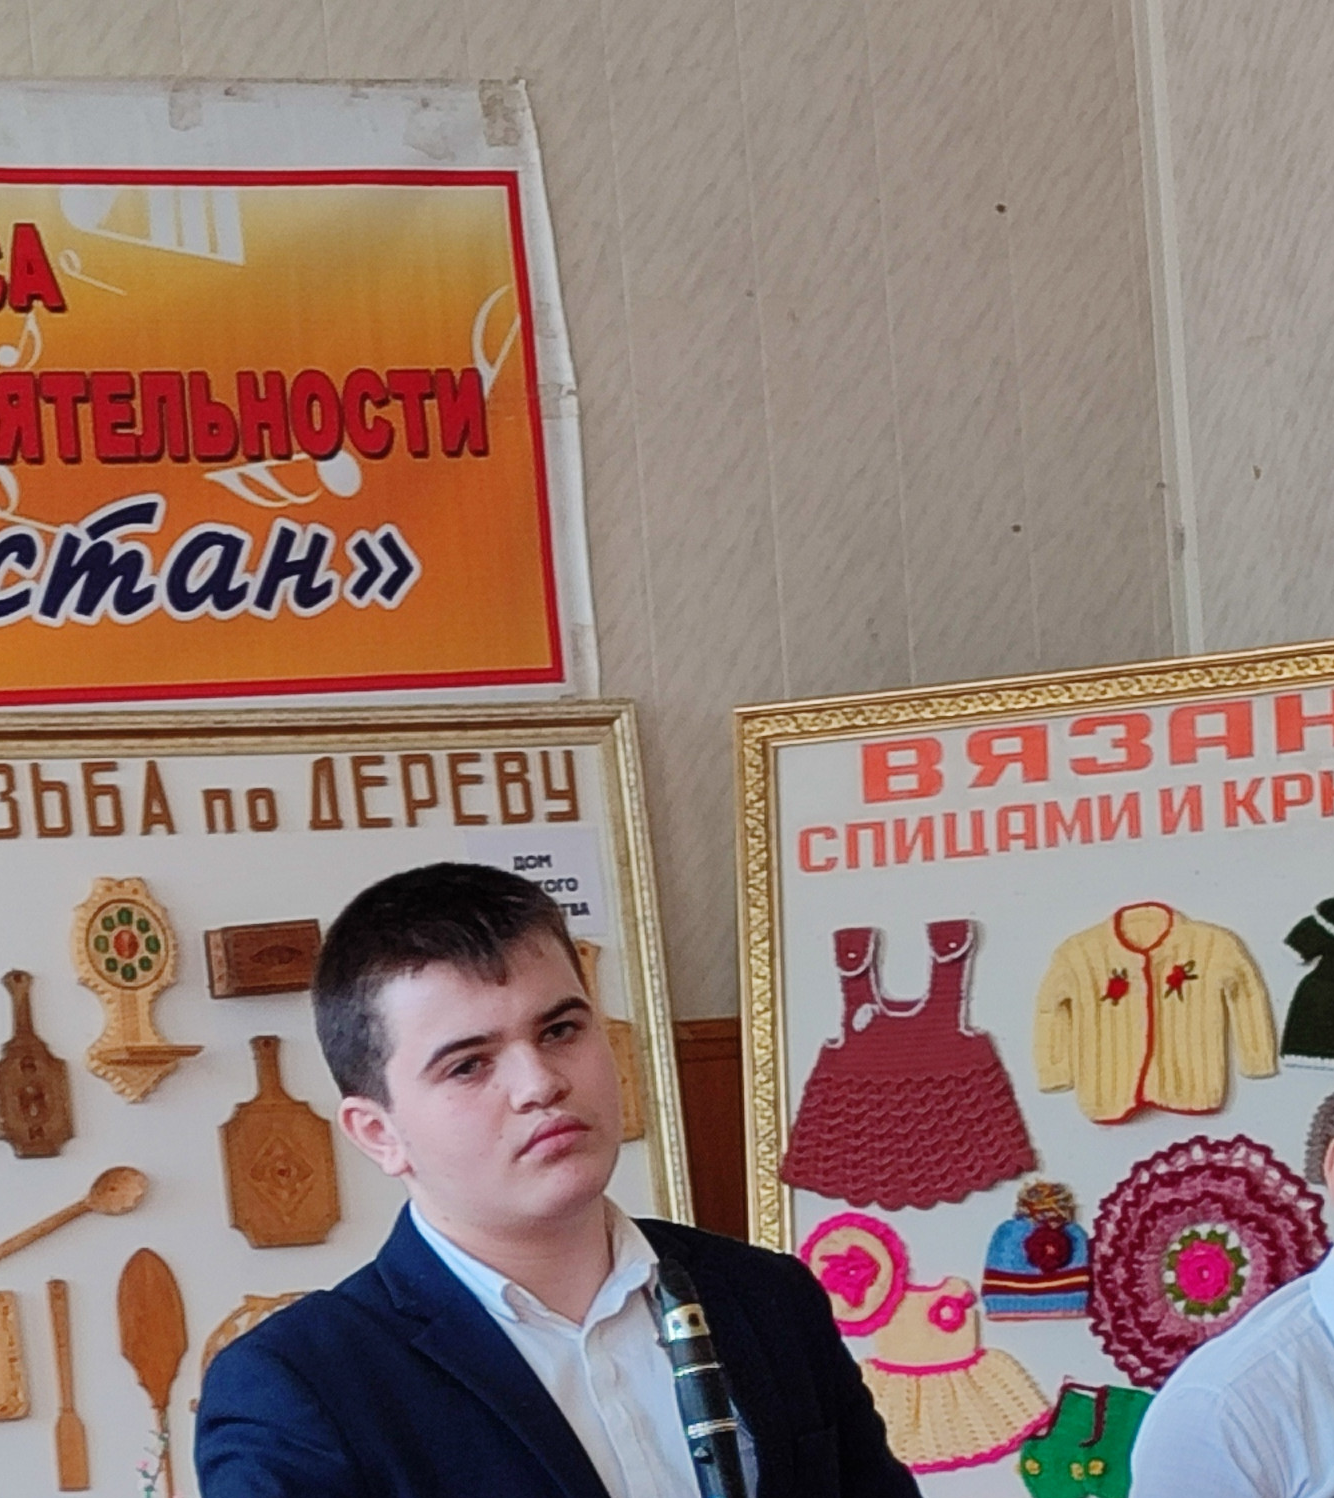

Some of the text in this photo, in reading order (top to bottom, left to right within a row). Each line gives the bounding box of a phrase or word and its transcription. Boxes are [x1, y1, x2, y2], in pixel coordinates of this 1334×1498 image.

[307, 750, 581, 831] ДЕРЕВУ
[798, 792, 1142, 873] СПИЦАМИ
[1159, 785, 1203, 835] И
